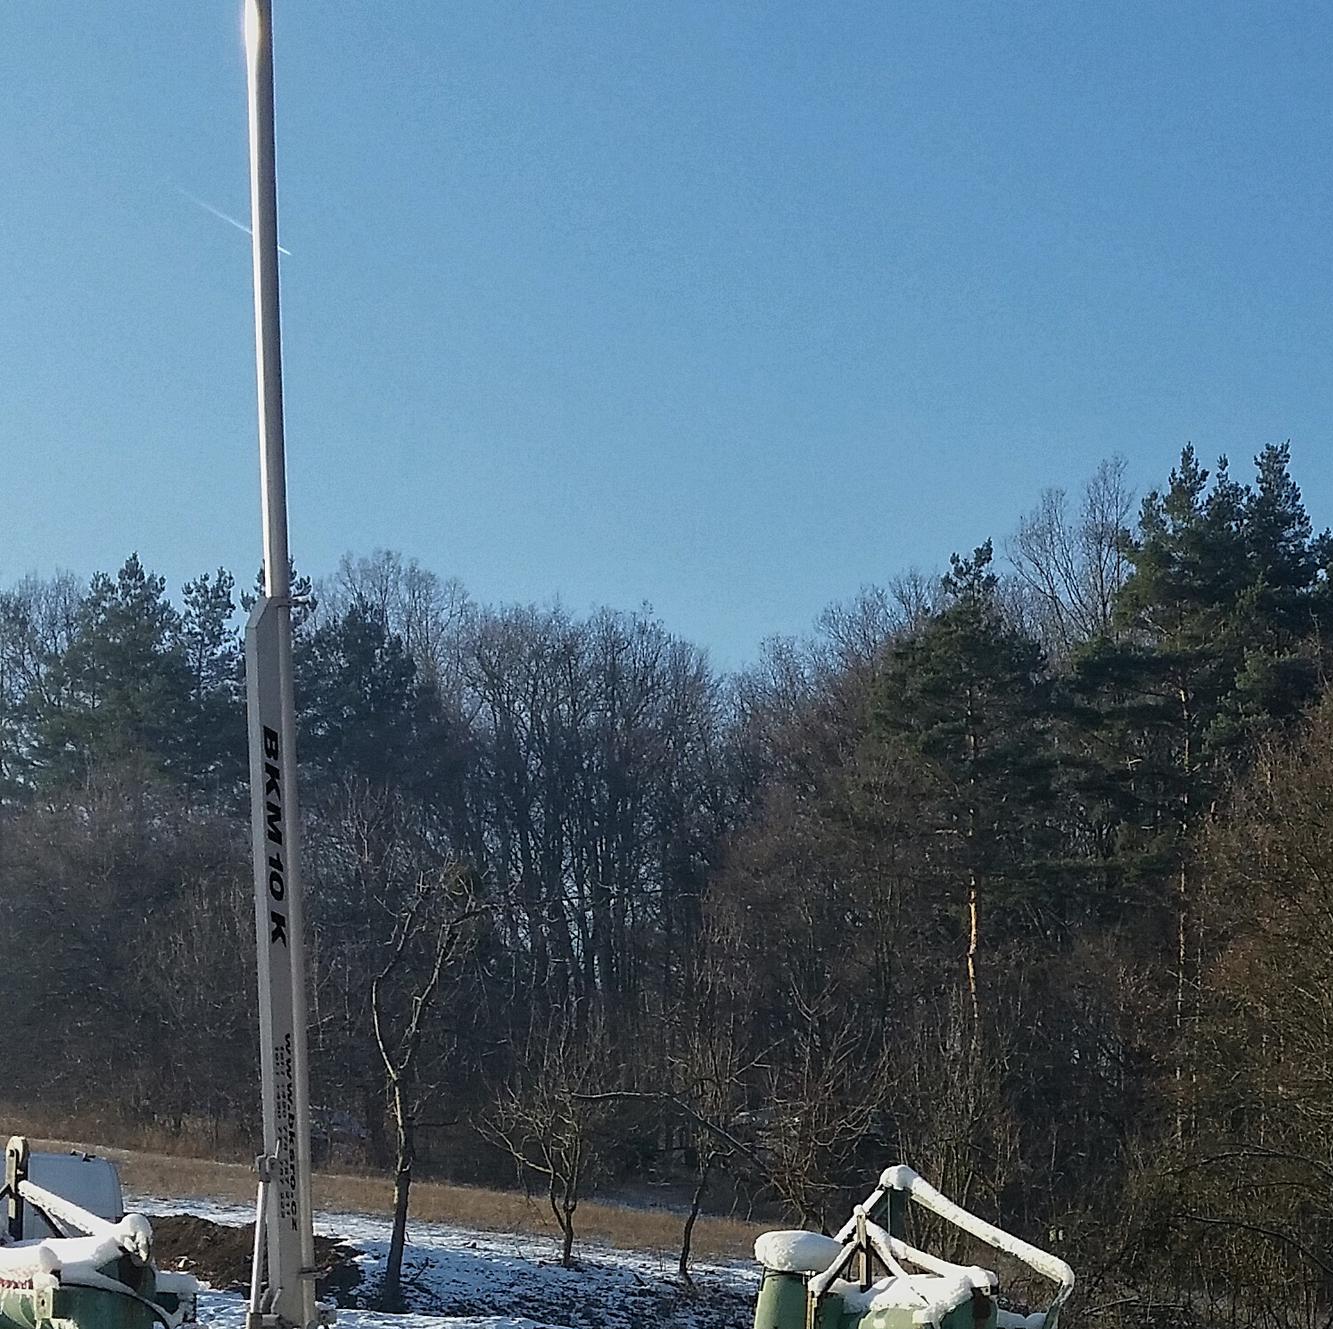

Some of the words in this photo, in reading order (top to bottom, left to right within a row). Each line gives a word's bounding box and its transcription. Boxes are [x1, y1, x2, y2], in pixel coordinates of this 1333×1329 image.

[263, 725, 283, 846] BKM
[269, 852, 285, 900] 10
[271, 911, 287, 948] K
